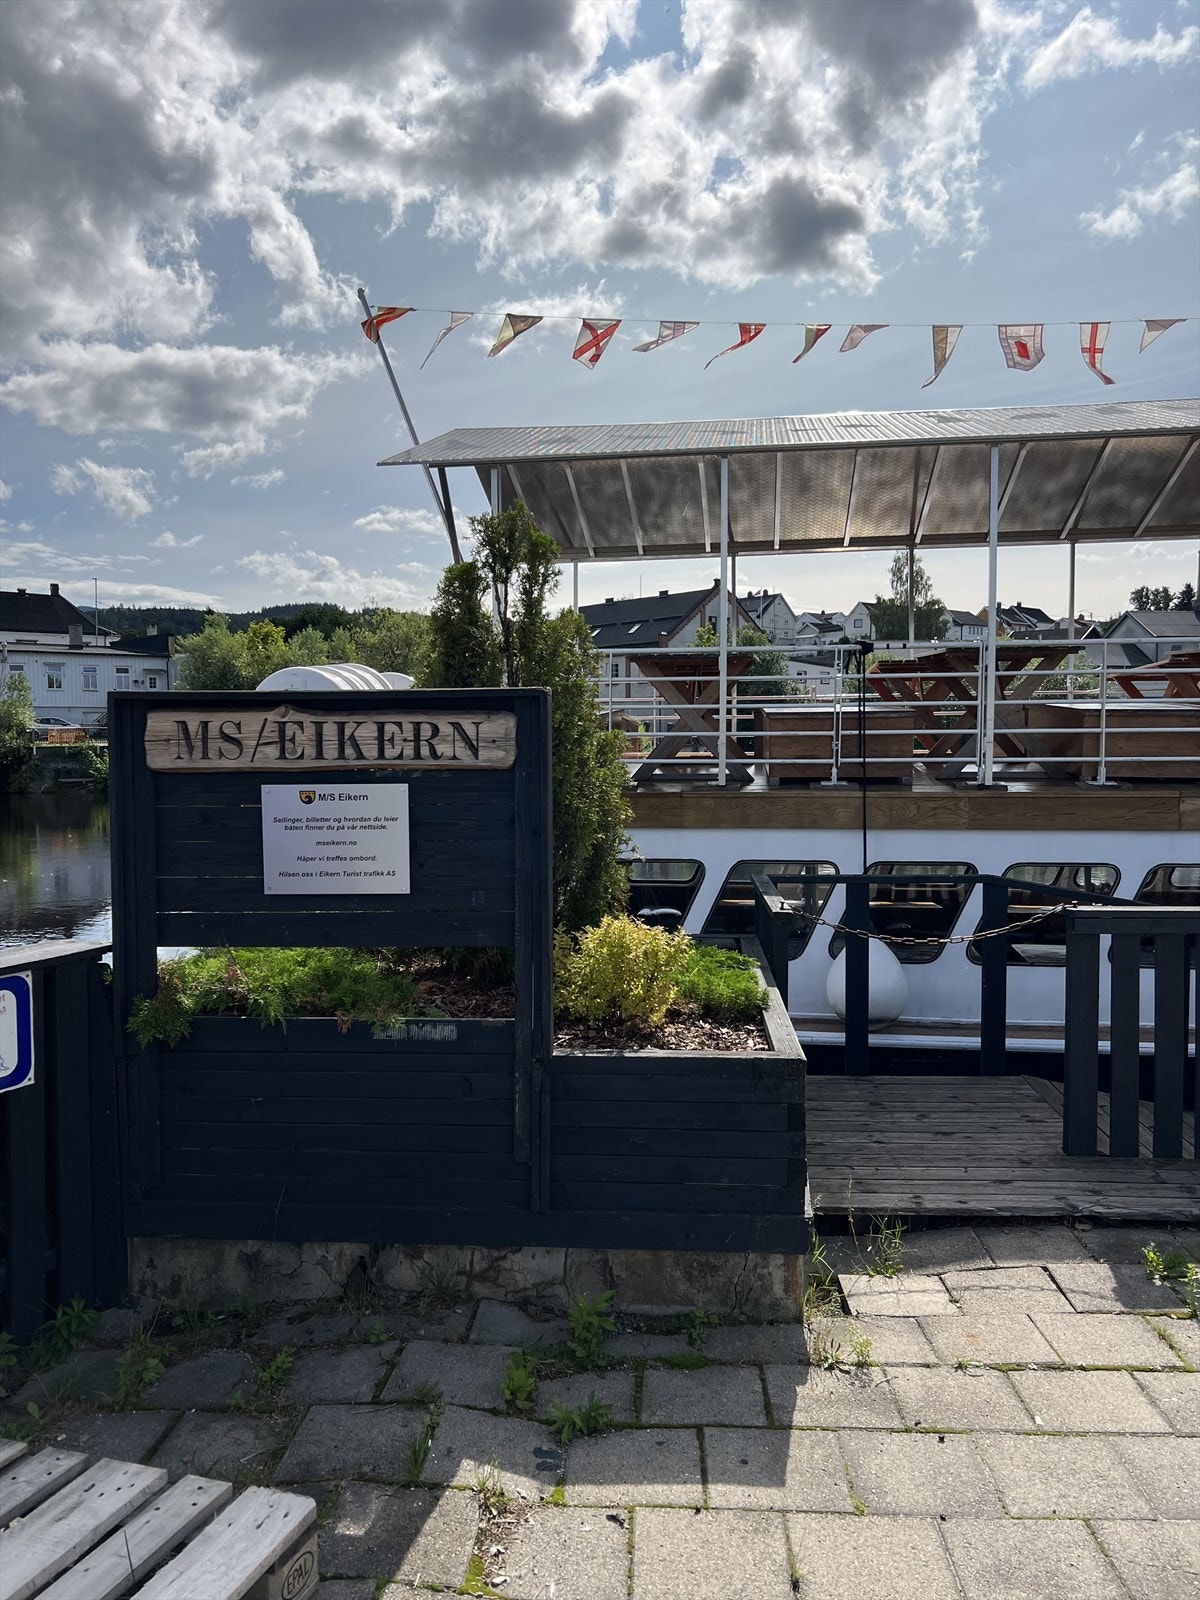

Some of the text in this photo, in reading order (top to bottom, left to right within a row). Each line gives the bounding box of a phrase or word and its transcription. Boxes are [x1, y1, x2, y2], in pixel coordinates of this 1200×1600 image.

[172, 717, 485, 763] MS/EIKERN
[318, 793, 368, 801] M/S Eikern
[336, 824, 345, 832] på
[296, 855, 317, 863] Håper
[286, 1556, 310, 1595] EPAL
